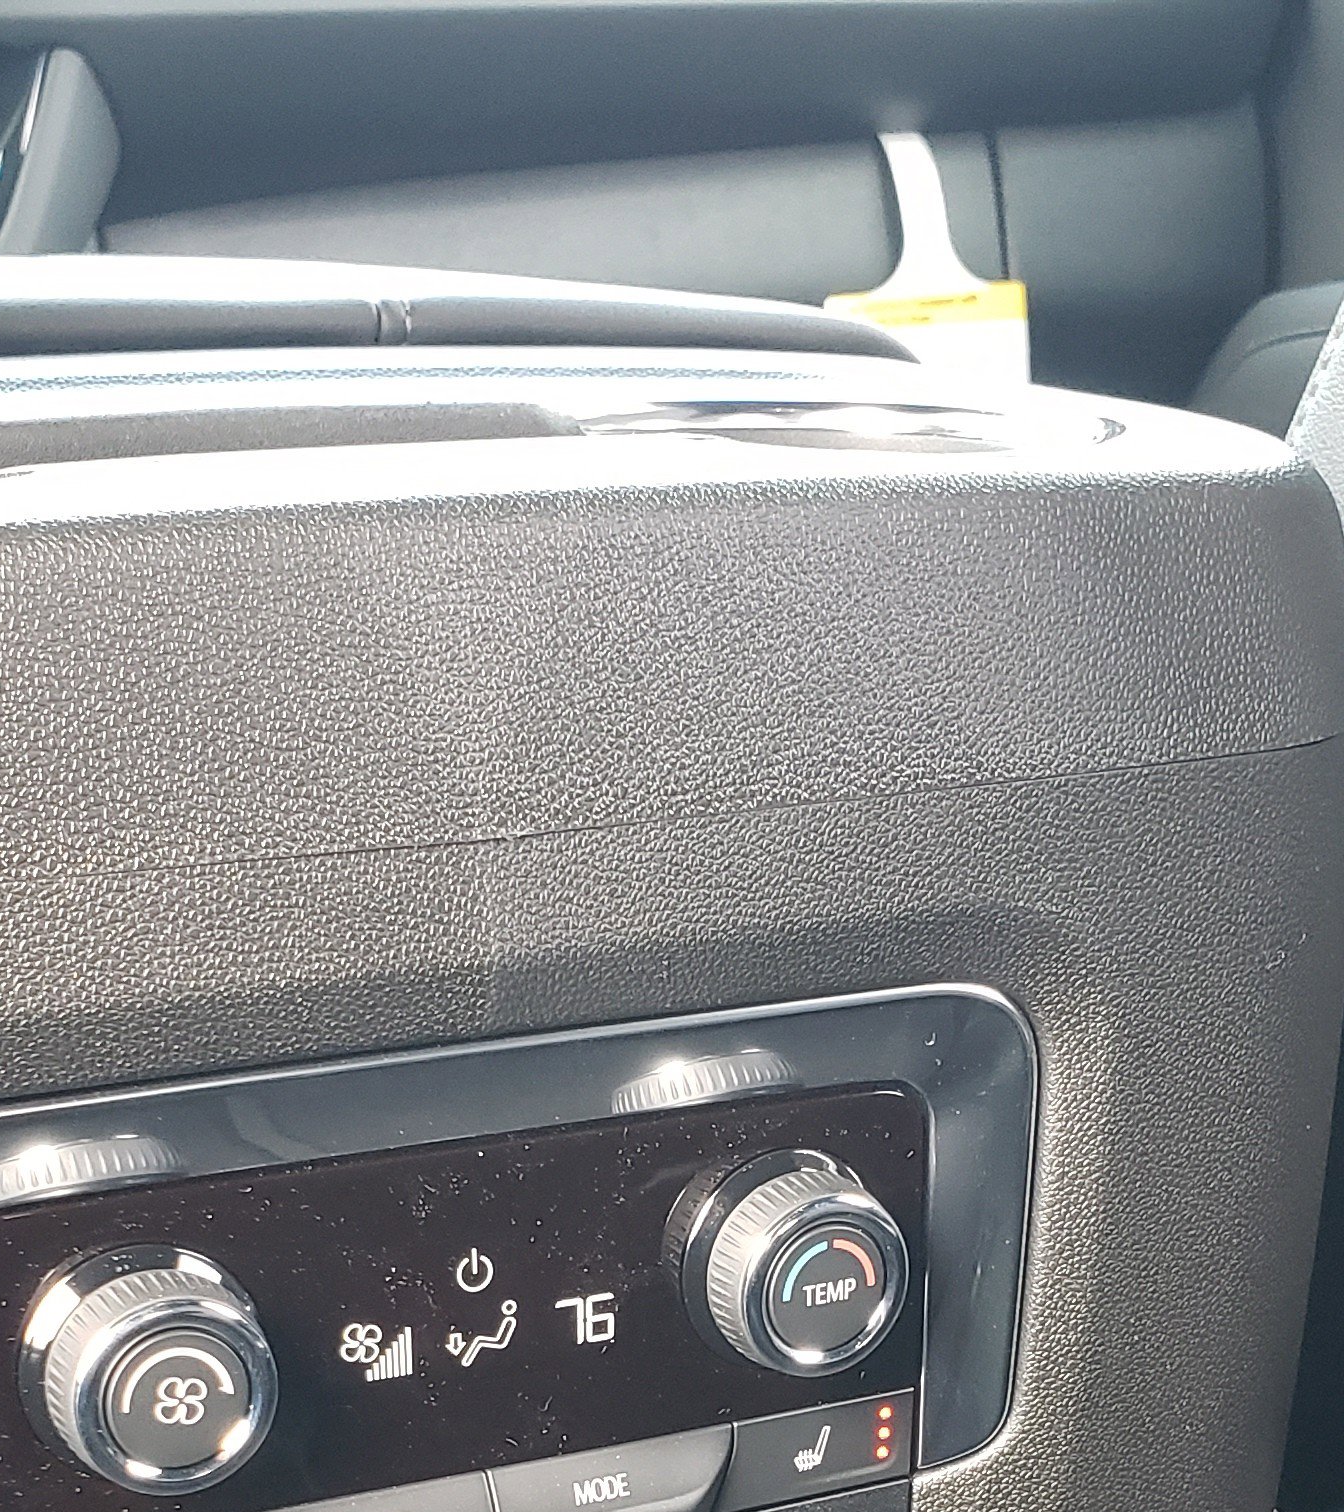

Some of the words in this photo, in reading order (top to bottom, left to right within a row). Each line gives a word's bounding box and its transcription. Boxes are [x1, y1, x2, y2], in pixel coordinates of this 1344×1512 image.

[801, 1277, 857, 1307] TEMP
[555, 1292, 615, 1345] 76
[572, 1472, 631, 1506] MODE
